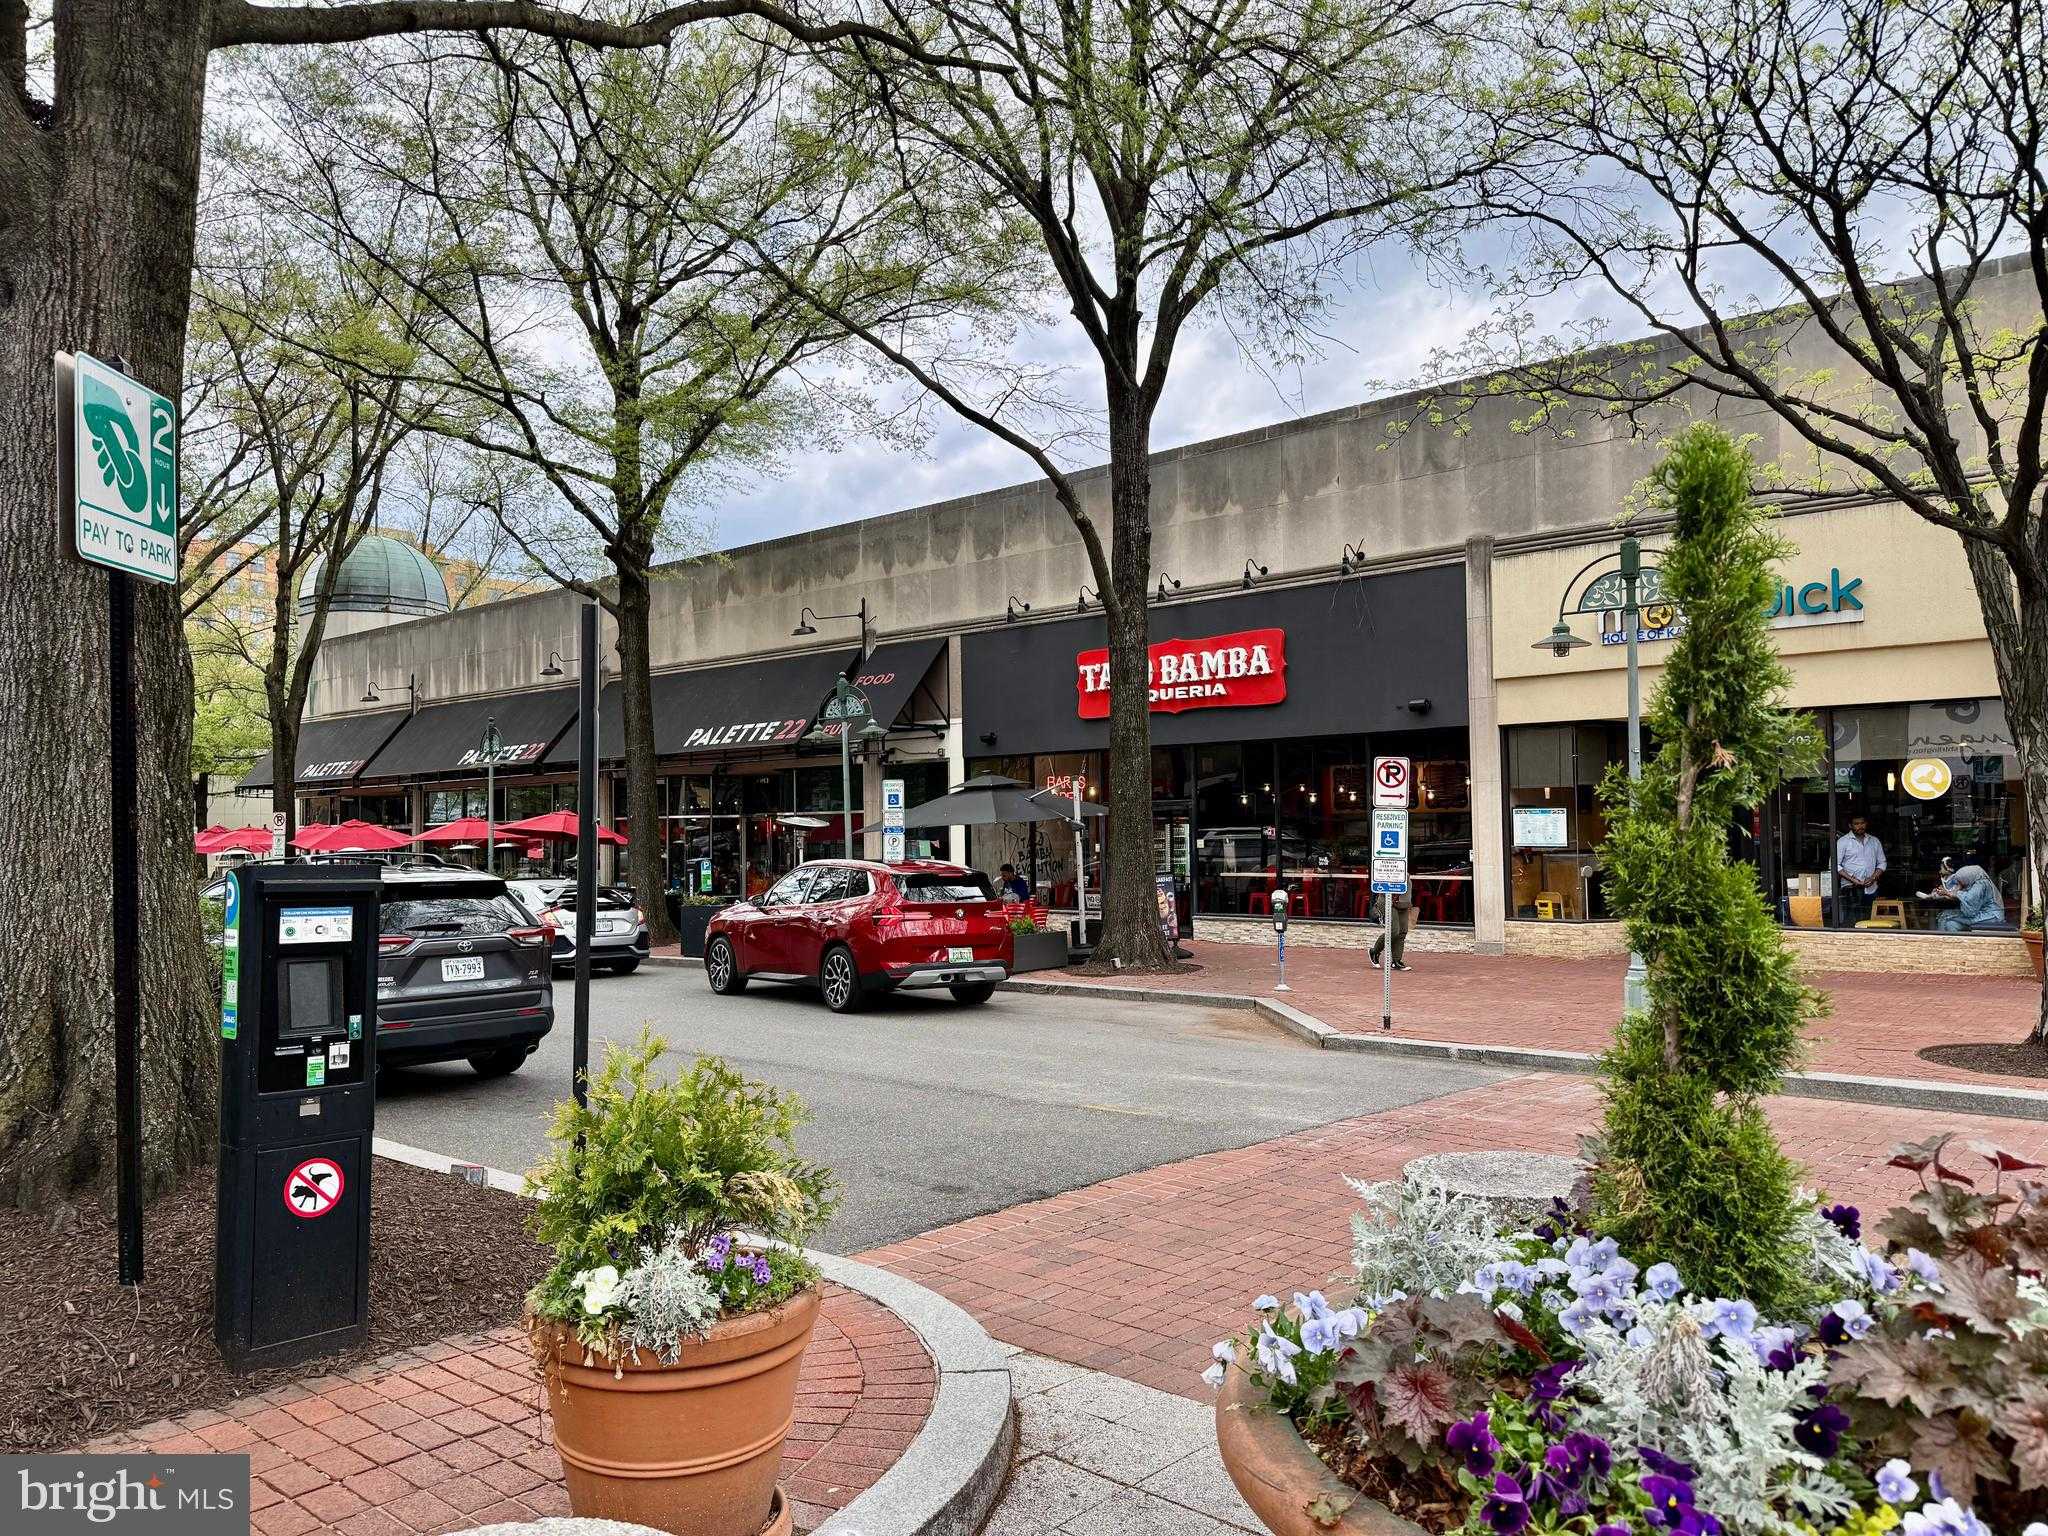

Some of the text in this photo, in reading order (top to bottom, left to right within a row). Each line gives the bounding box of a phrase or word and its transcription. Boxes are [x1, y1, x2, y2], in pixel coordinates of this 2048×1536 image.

[152, 407, 173, 457] 2
[154, 457, 171, 470] HOUR
[83, 518, 172, 567] PAY TO PARK
[1602, 629, 1644, 643] HOUE
[1160, 644, 1274, 685] BAMBA
[854, 672, 896, 688] FOOD
[1148, 683, 1228, 703] QUERIA
[1376, 813, 1406, 821] RESERVED
[1377, 821, 1404, 829] PARKING
